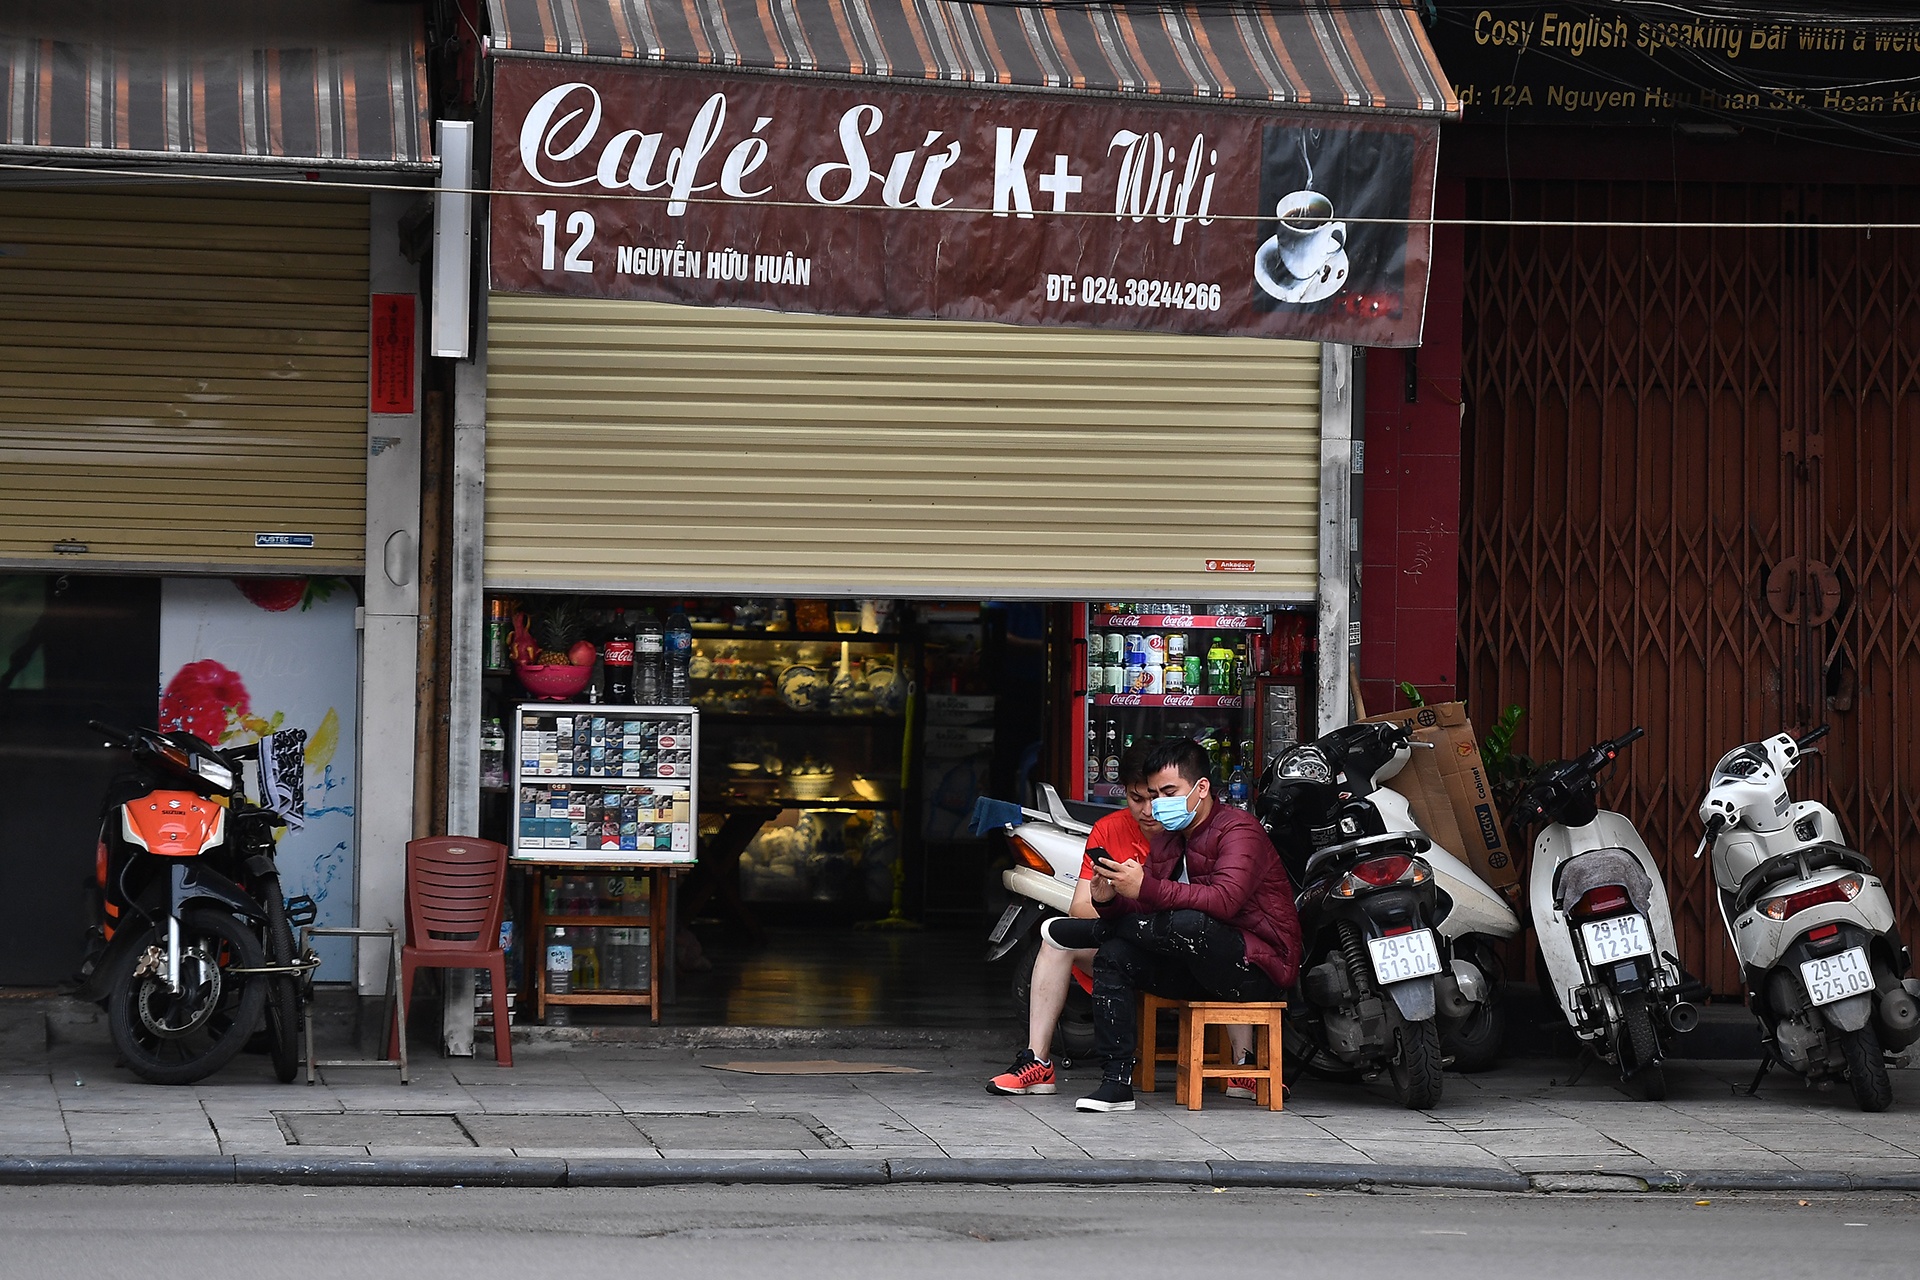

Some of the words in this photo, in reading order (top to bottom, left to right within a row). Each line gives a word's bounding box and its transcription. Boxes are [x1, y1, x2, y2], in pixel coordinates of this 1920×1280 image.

[1474, 10, 1534, 54] Cosy
[1540, 13, 1628, 57] English
[1637, 18, 1743, 58] speaking
[1491, 85, 1534, 106] 12A
[1547, 85, 1636, 111] Nguyen
[1699, 88, 1760, 109] Huan
[1823, 90, 1884, 112] Hoan
[520, 83, 773, 216] Café
[806, 104, 961, 209] Sứ
[992, 127, 1083, 219] K+
[1107, 129, 1219, 245] Wifi
[536, 210, 595, 273] 12
[617, 240, 701, 279] NGUYỄN
[707, 248, 749, 282] HỮU
[754, 251, 811, 286] HUÂN
[1046, 274, 1076, 302] ĐT:
[1082, 276, 1221, 312] 024.38244266
[258, 535, 289, 543] AUSTEC
[1472, 767, 1486, 799] Cabinet
[1478, 811, 1497, 843] LUCKY
[1592, 916, 1639, 942] 29-H2
[1379, 934, 1425, 960] 29-C1
[1597, 935, 1643, 960] 1234
[1379, 953, 1436, 980] 513.04
[1811, 952, 1858, 981] 29-C1
[1812, 970, 1870, 1002] 525.09
